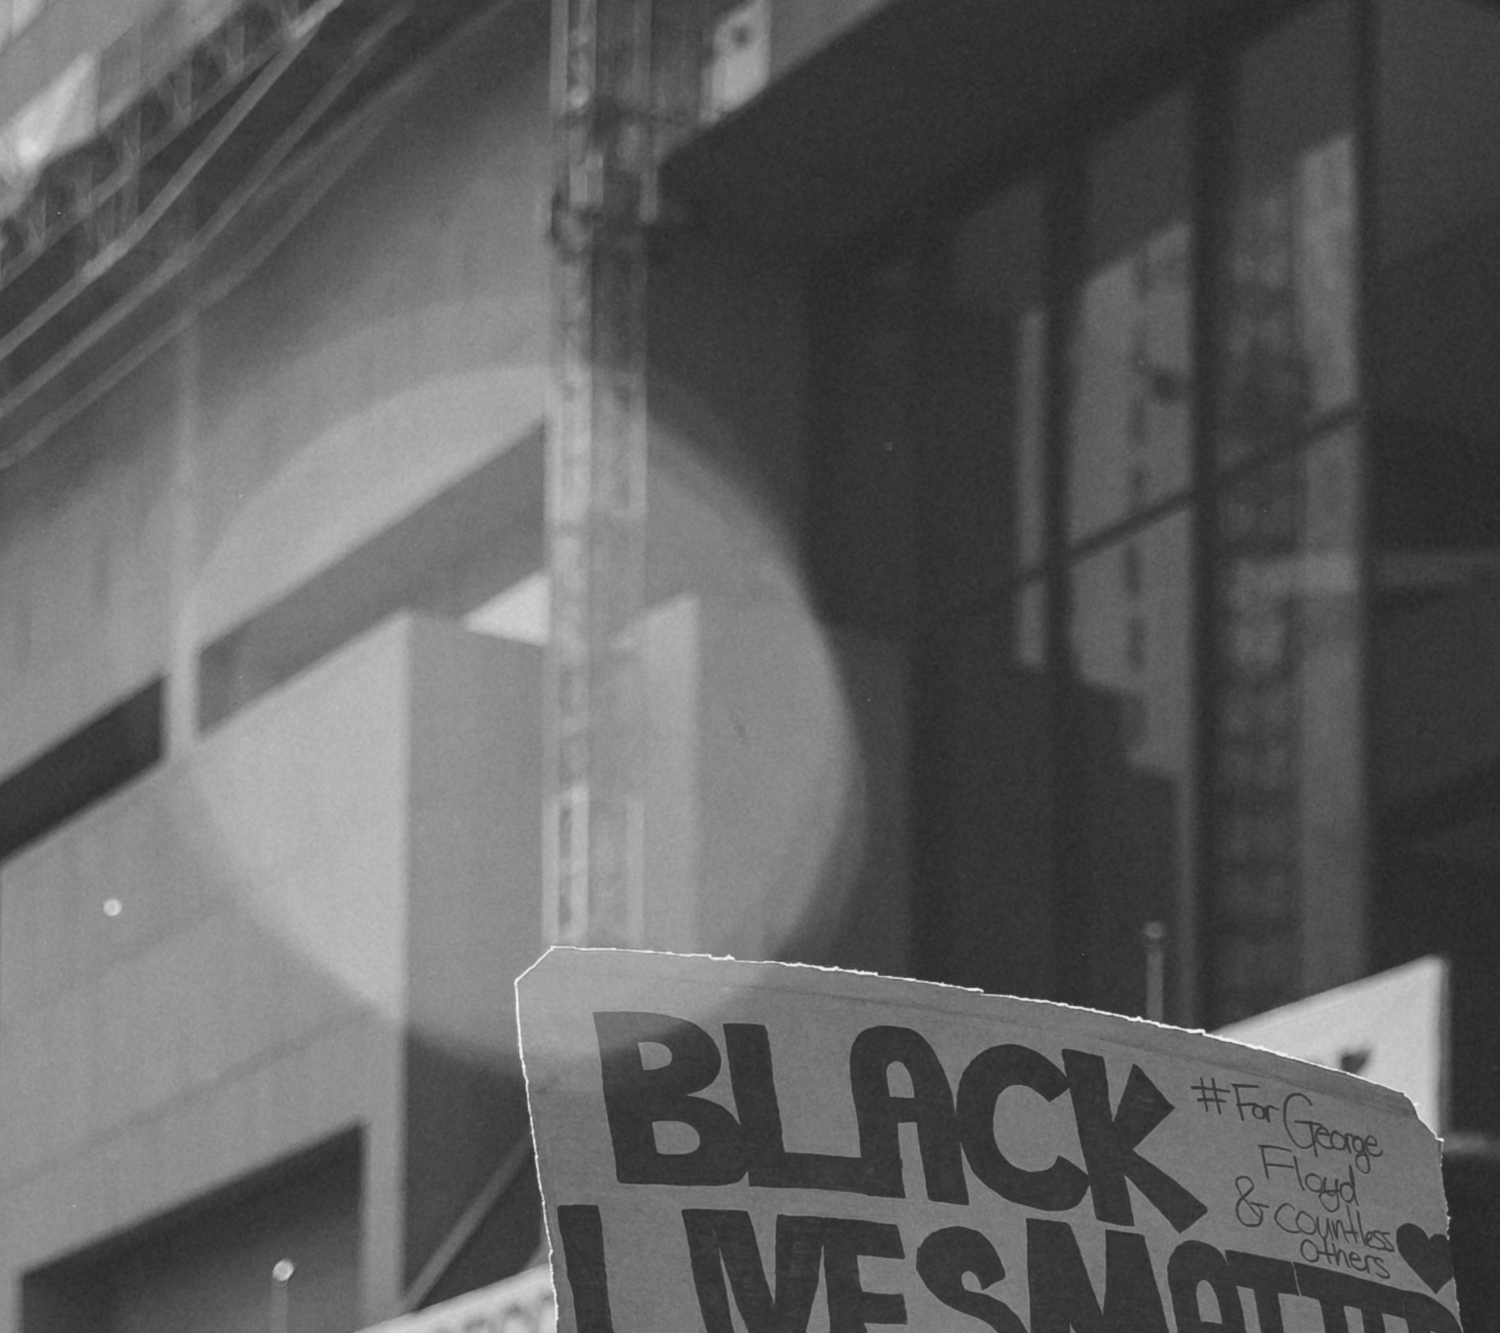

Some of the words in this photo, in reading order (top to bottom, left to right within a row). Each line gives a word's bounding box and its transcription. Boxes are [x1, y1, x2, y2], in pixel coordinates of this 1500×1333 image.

[593, 1011, 1208, 1233] BLACK
[1190, 1077, 1279, 1123] #For
[1282, 1092, 1383, 1175] George
[1235, 1175, 1270, 1228] &
[1258, 1144, 1359, 1213] Floyd
